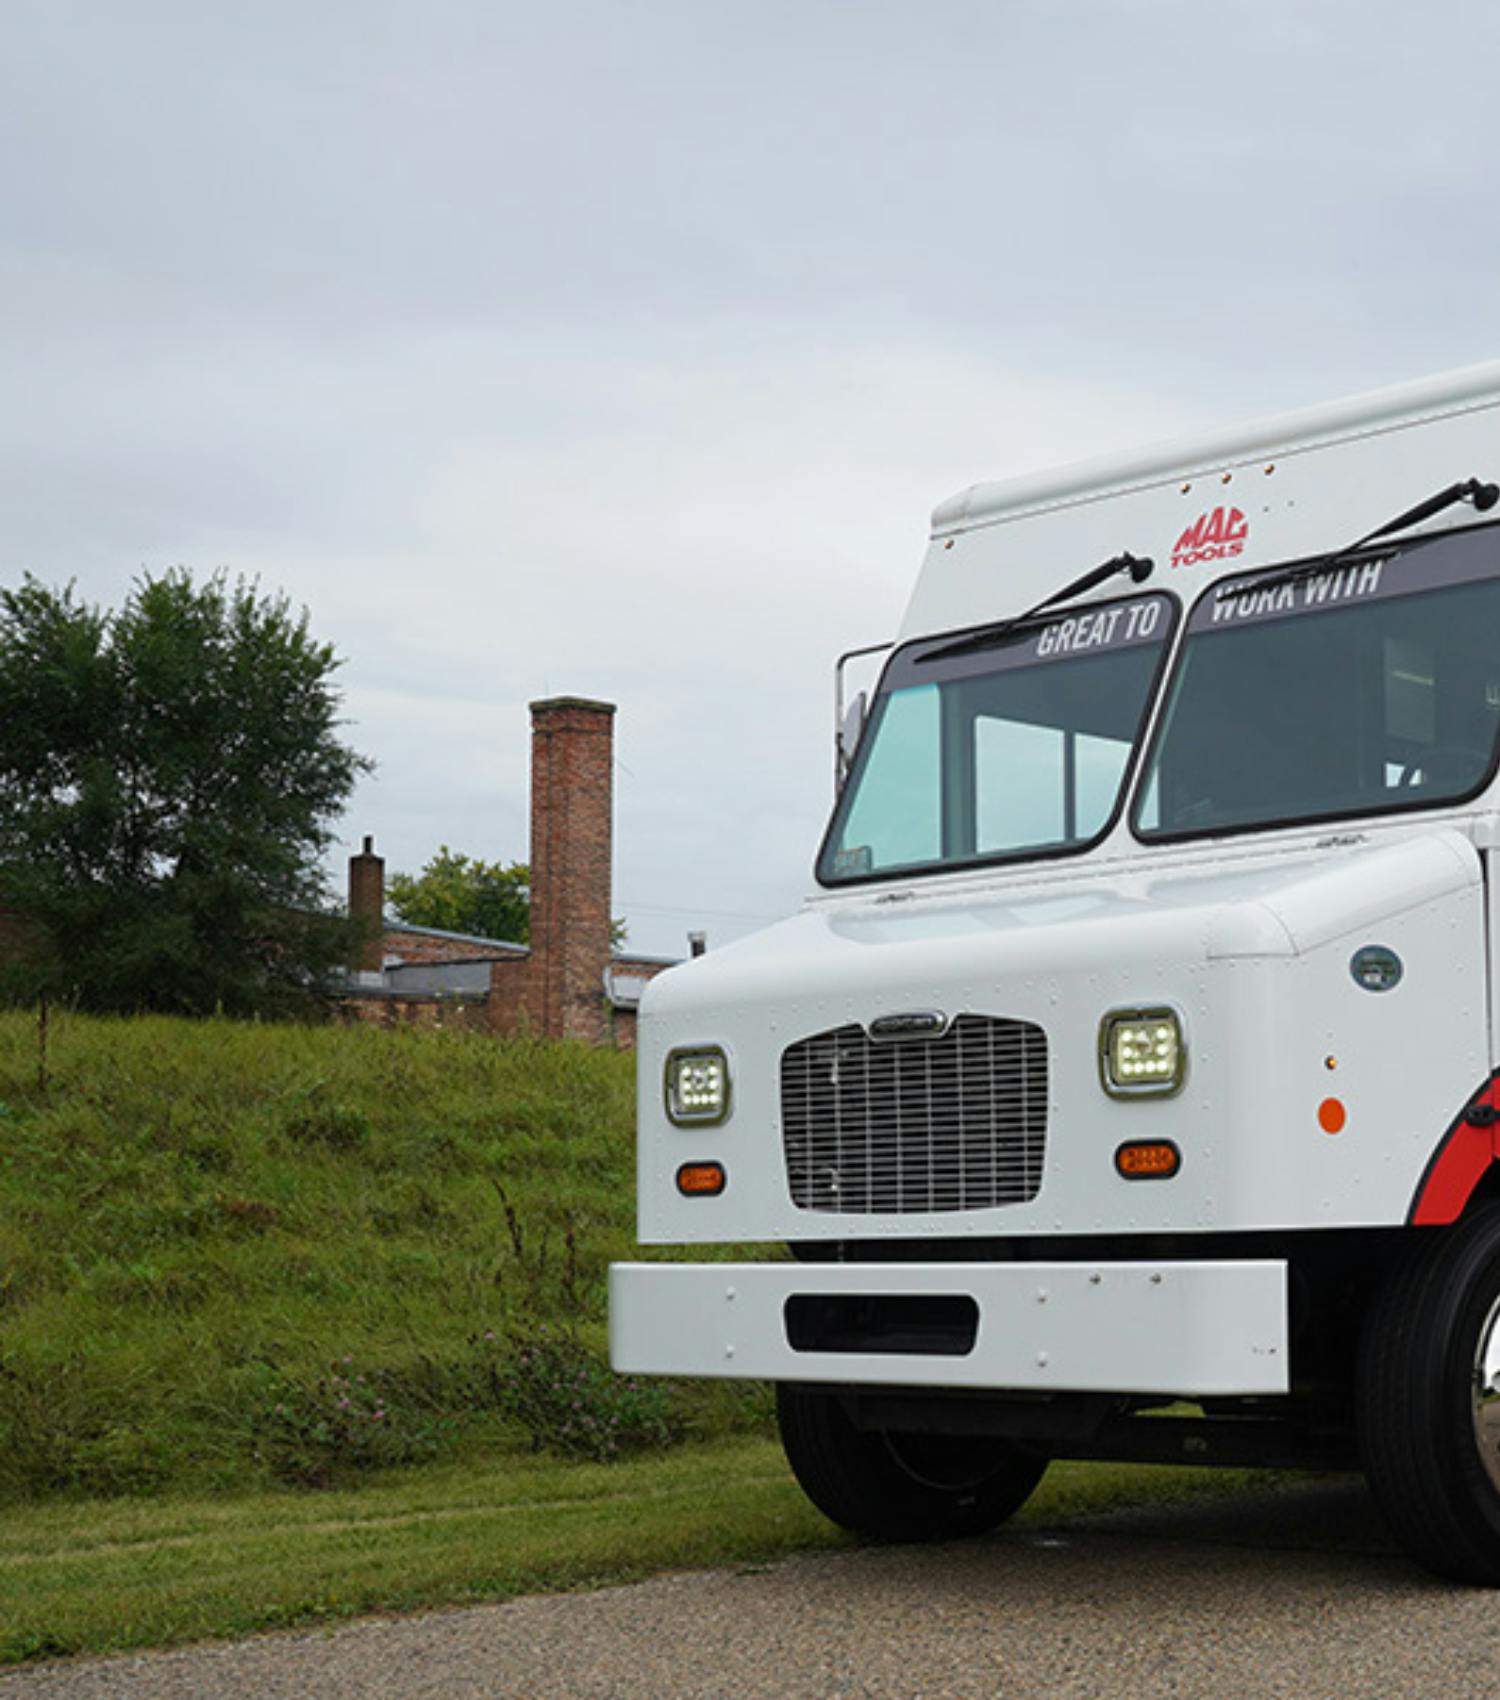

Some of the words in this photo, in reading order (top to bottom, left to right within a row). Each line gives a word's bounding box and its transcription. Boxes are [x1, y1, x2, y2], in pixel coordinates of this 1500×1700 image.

[1173, 506, 1248, 553] MAC
[1171, 541, 1243, 568] TOOLS
[1037, 608, 1124, 656] GREAT
[1125, 601, 1160, 640] TO
